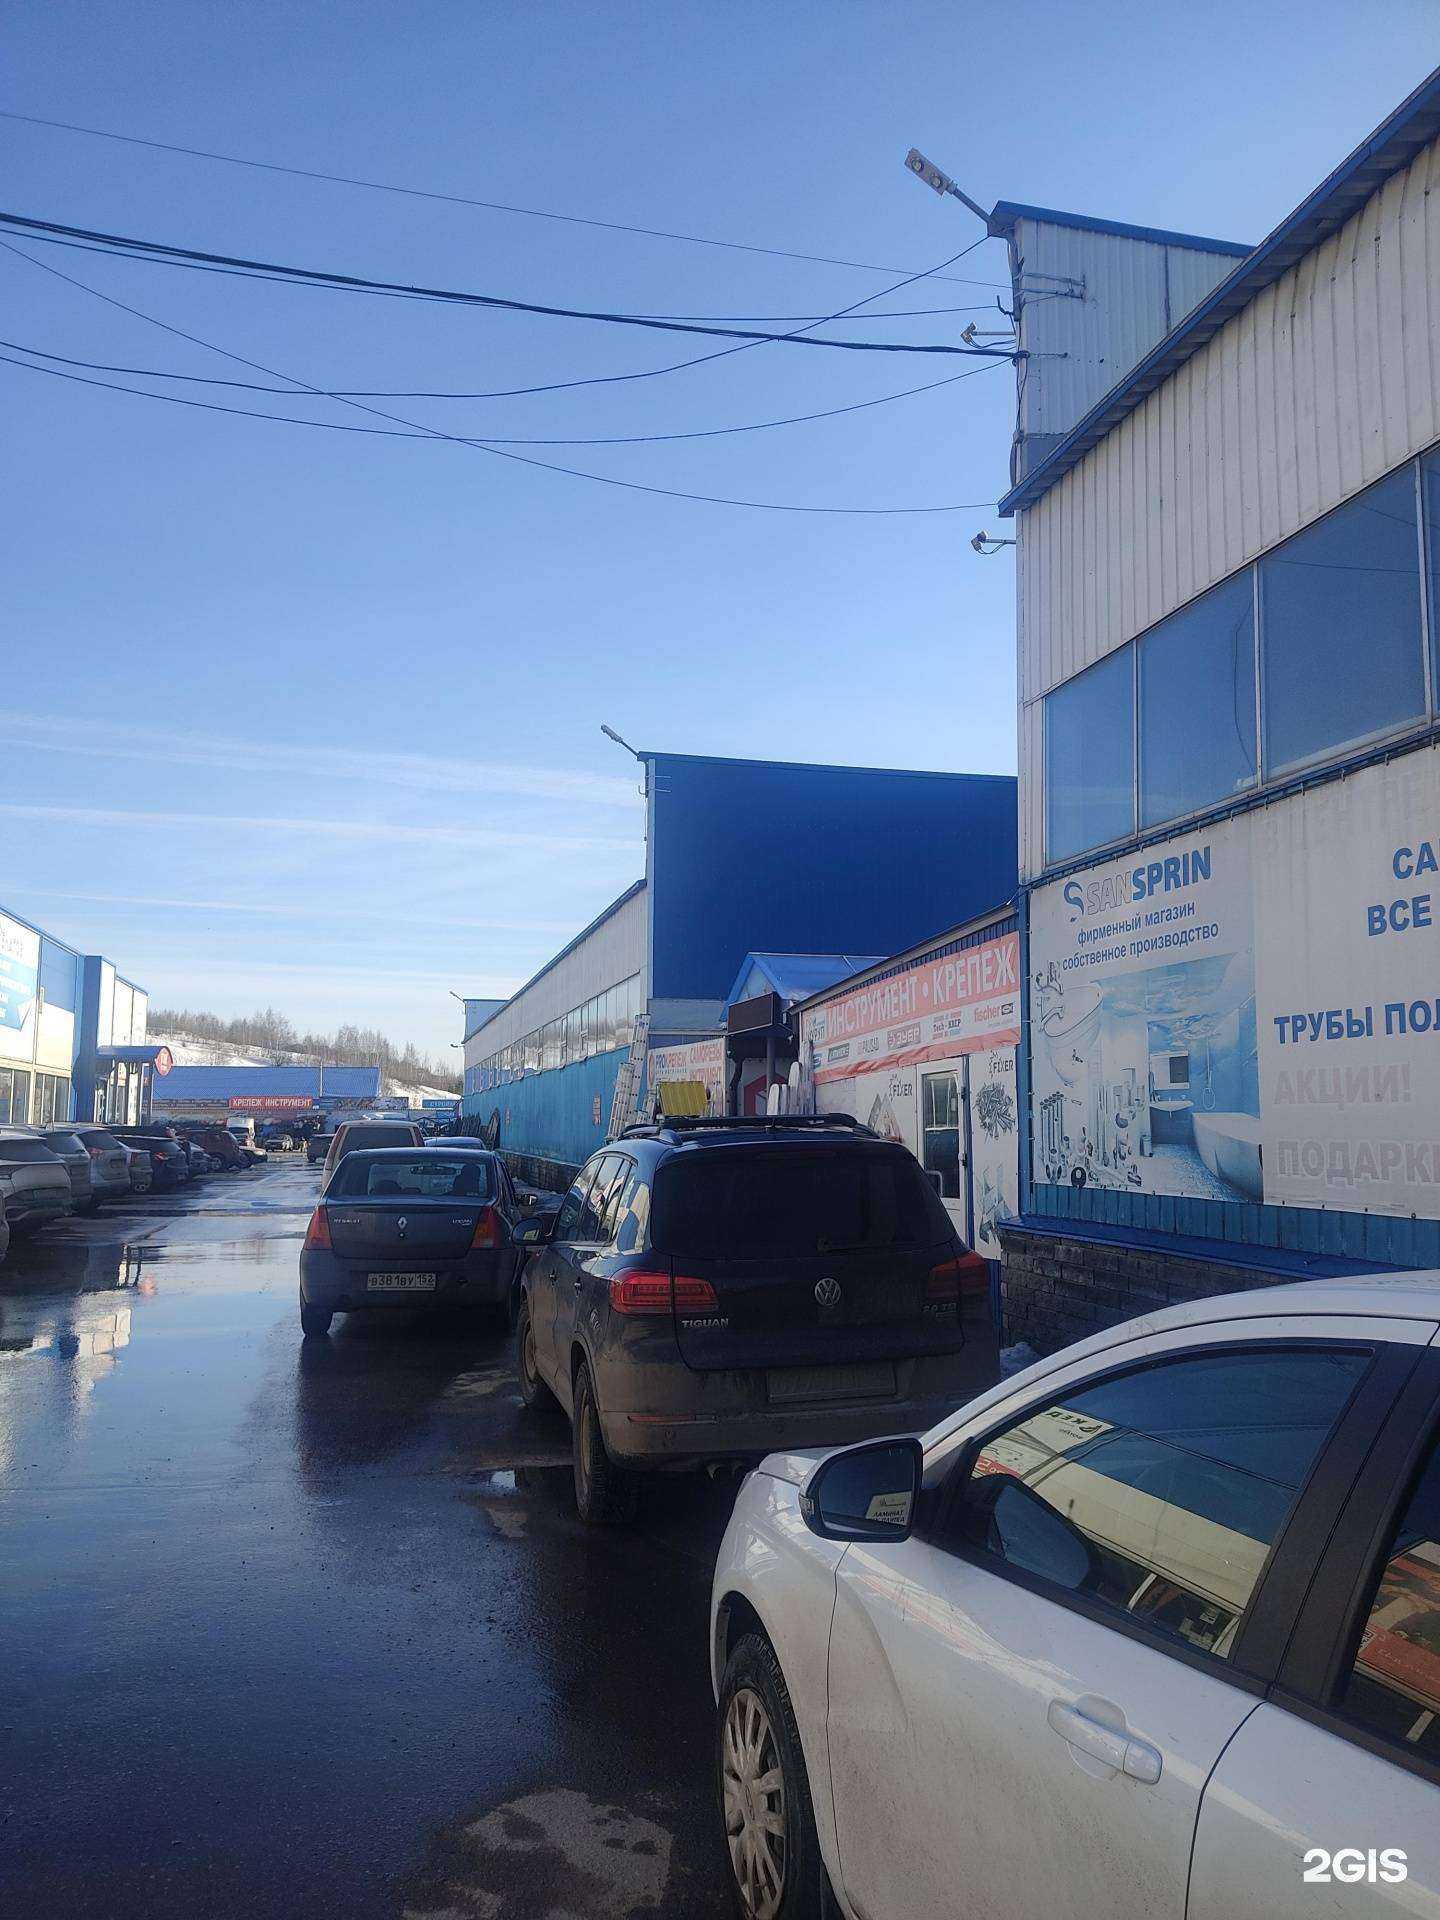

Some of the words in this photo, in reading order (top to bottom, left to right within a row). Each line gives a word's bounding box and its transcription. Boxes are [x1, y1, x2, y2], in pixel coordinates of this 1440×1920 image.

[1086, 846, 1211, 916] SANSPRIN
[1077, 912, 1142, 948] фирменный
[1145, 901, 1195, 927] магазин
[1367, 894, 1432, 937] ВСЕ
[1062, 944, 1127, 971] собственное
[1129, 923, 1219, 958] производство
[827, 974, 918, 1038] ИНСТРУМЕНТ
[932, 942, 1016, 1008] КРЕПЕЖ
[1273, 1006, 1373, 1044] ТРУБЫ
[993, 1059, 1014, 1074] FIXER
[1274, 1062, 1412, 1111] АКЦИИ!
[265, 1097, 312, 1107] ИНСТРУМЕНТ
[892, 1083, 913, 1097] FIXER
[681, 1318, 729, 1329] TIGUAN
